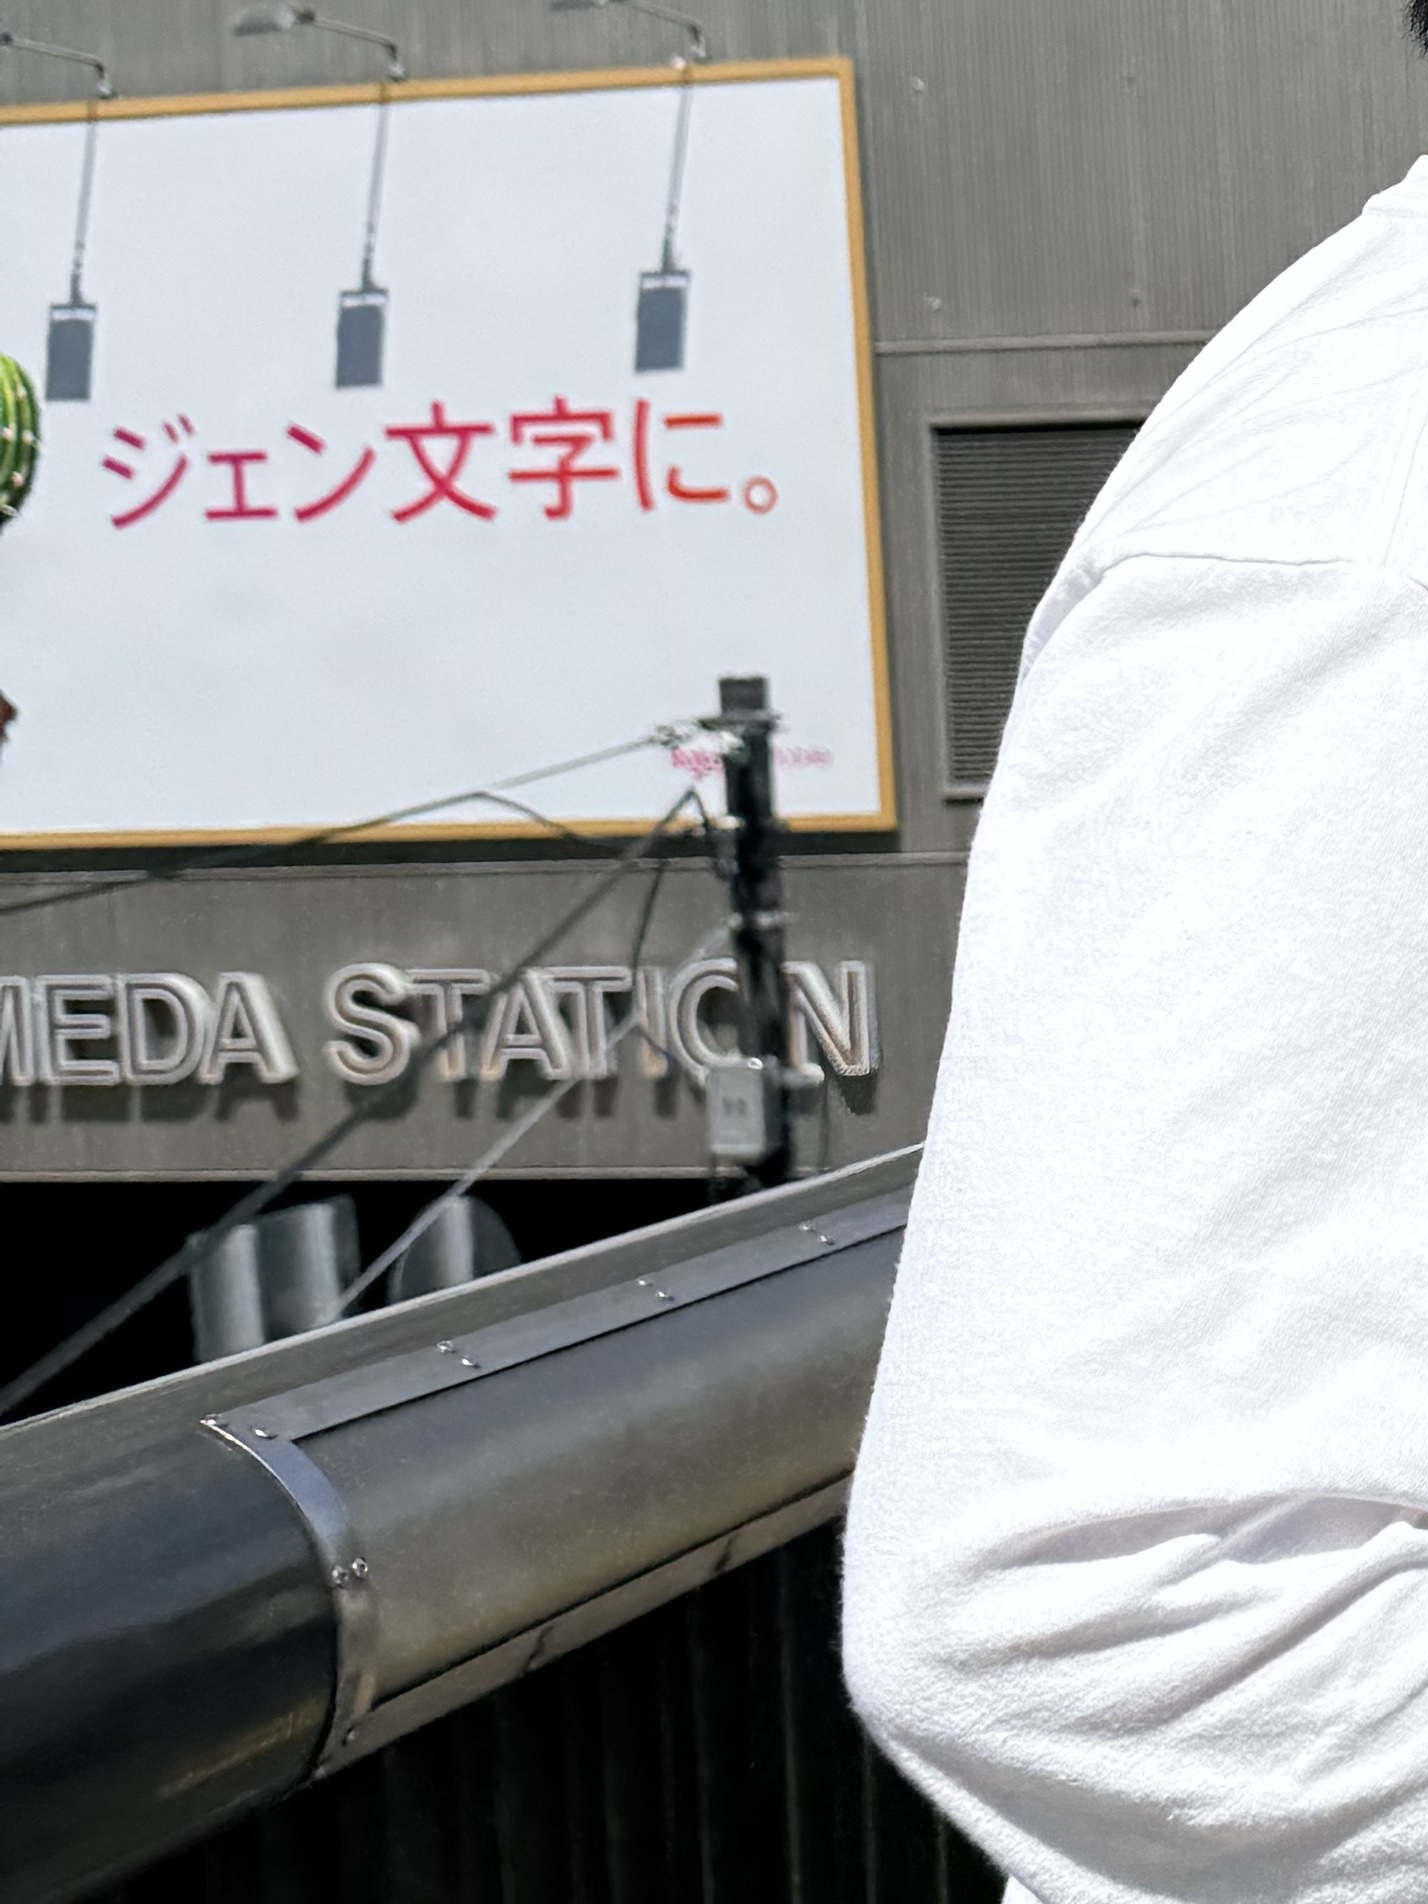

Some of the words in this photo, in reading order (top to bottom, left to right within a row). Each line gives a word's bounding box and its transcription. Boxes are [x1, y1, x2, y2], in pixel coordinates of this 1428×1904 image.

[101, 394, 778, 529] ジェン文字に。
